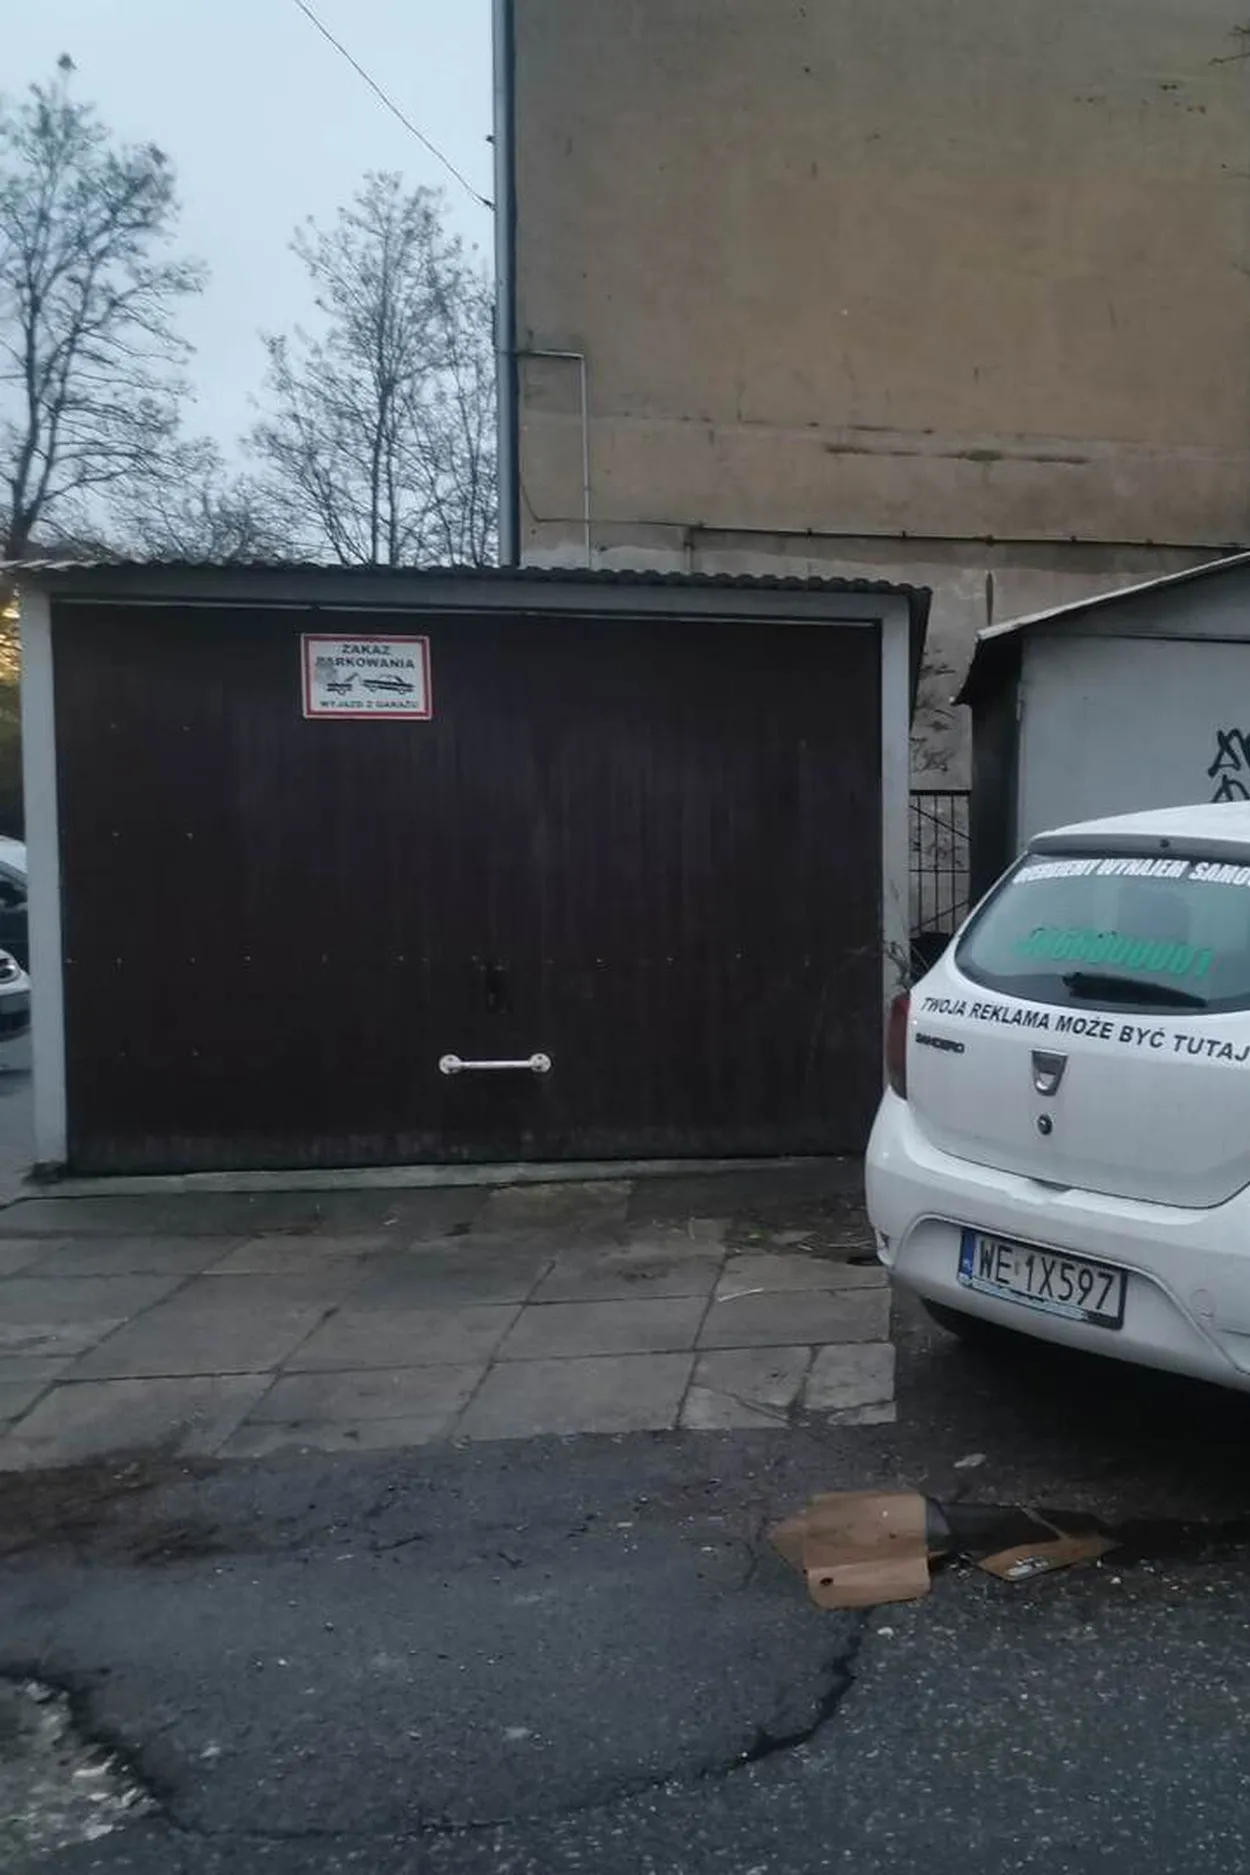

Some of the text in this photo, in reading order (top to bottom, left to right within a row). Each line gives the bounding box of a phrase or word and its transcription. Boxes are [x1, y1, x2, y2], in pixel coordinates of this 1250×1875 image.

[315, 656, 415, 669] PARKOWANIA
[342, 644, 391, 655] ZAKAZ
[920, 997, 967, 1017] TWOJA
[970, 1003, 1049, 1030] REKLAMA
[1055, 1015, 1114, 1040] MOŻE
[1119, 1024, 1165, 1049] BYĆ
[979, 1239, 1115, 1310] WE 1X597
